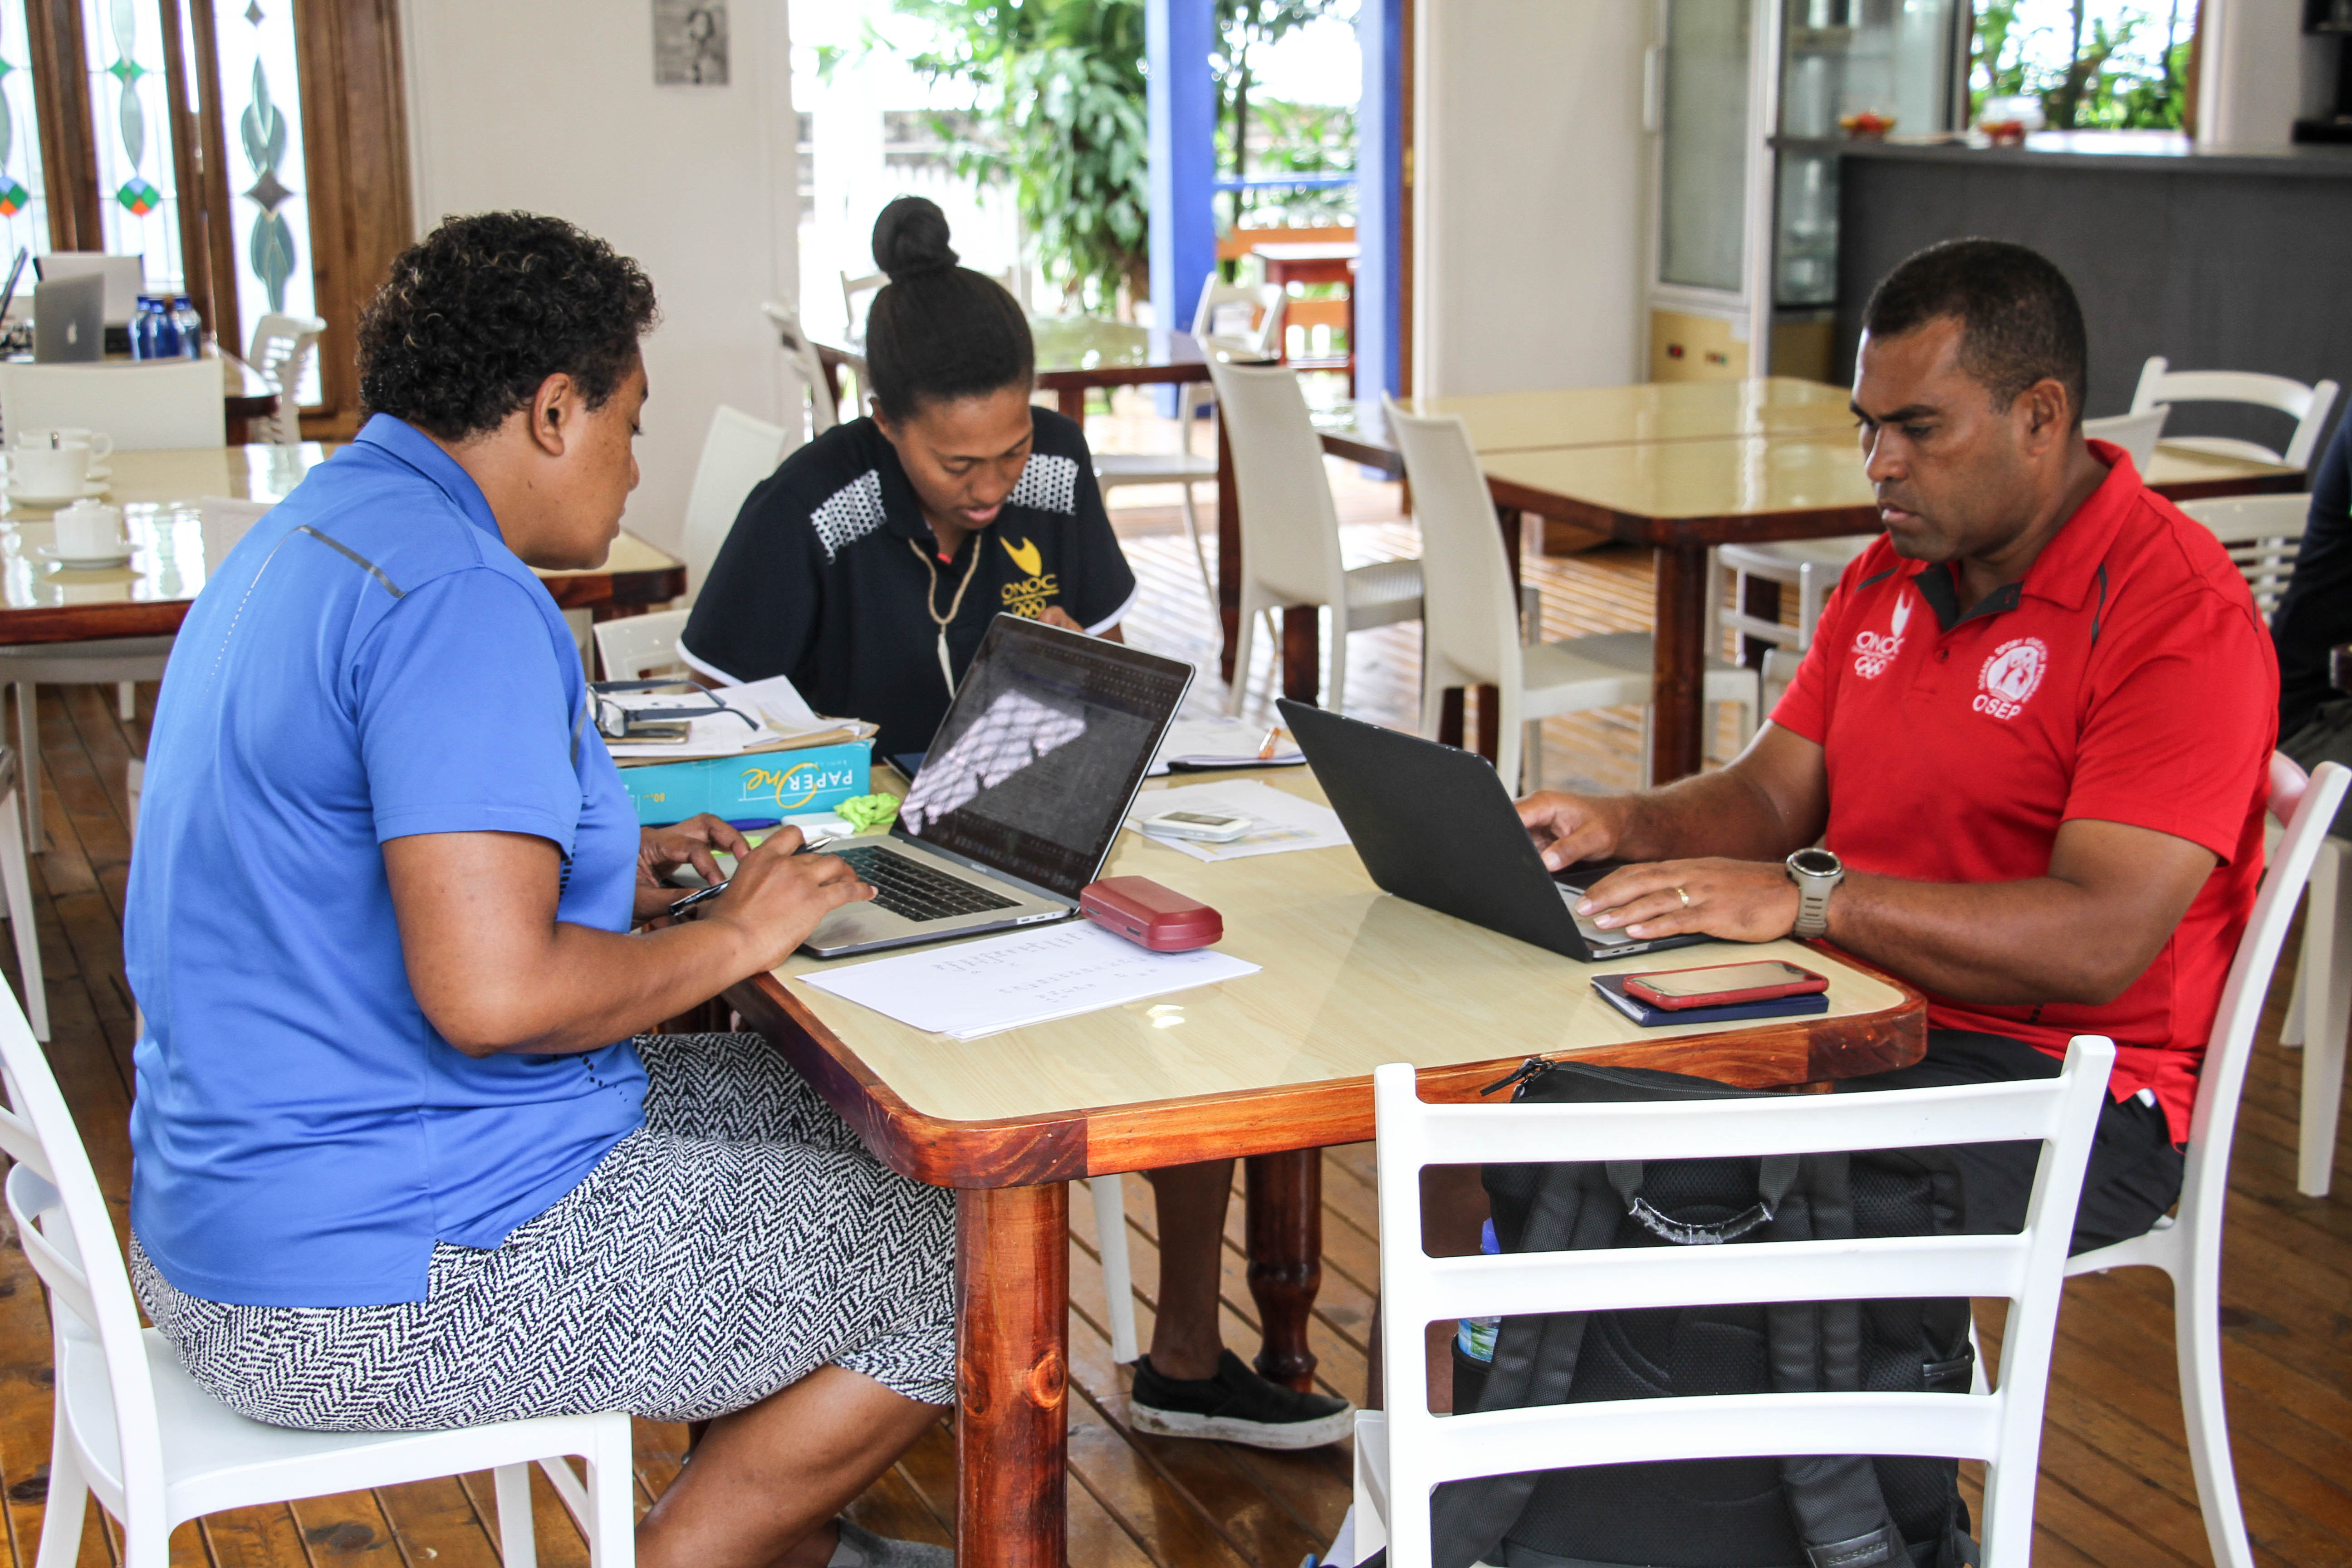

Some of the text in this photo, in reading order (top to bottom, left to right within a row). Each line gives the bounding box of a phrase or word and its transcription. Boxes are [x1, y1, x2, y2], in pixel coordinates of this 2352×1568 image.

[1001, 574, 1058, 599] ONOC
[1856, 631, 1906, 655] ONOC
[1973, 694, 2022, 720] OSEP
[740, 763, 853, 809] PAPER One
